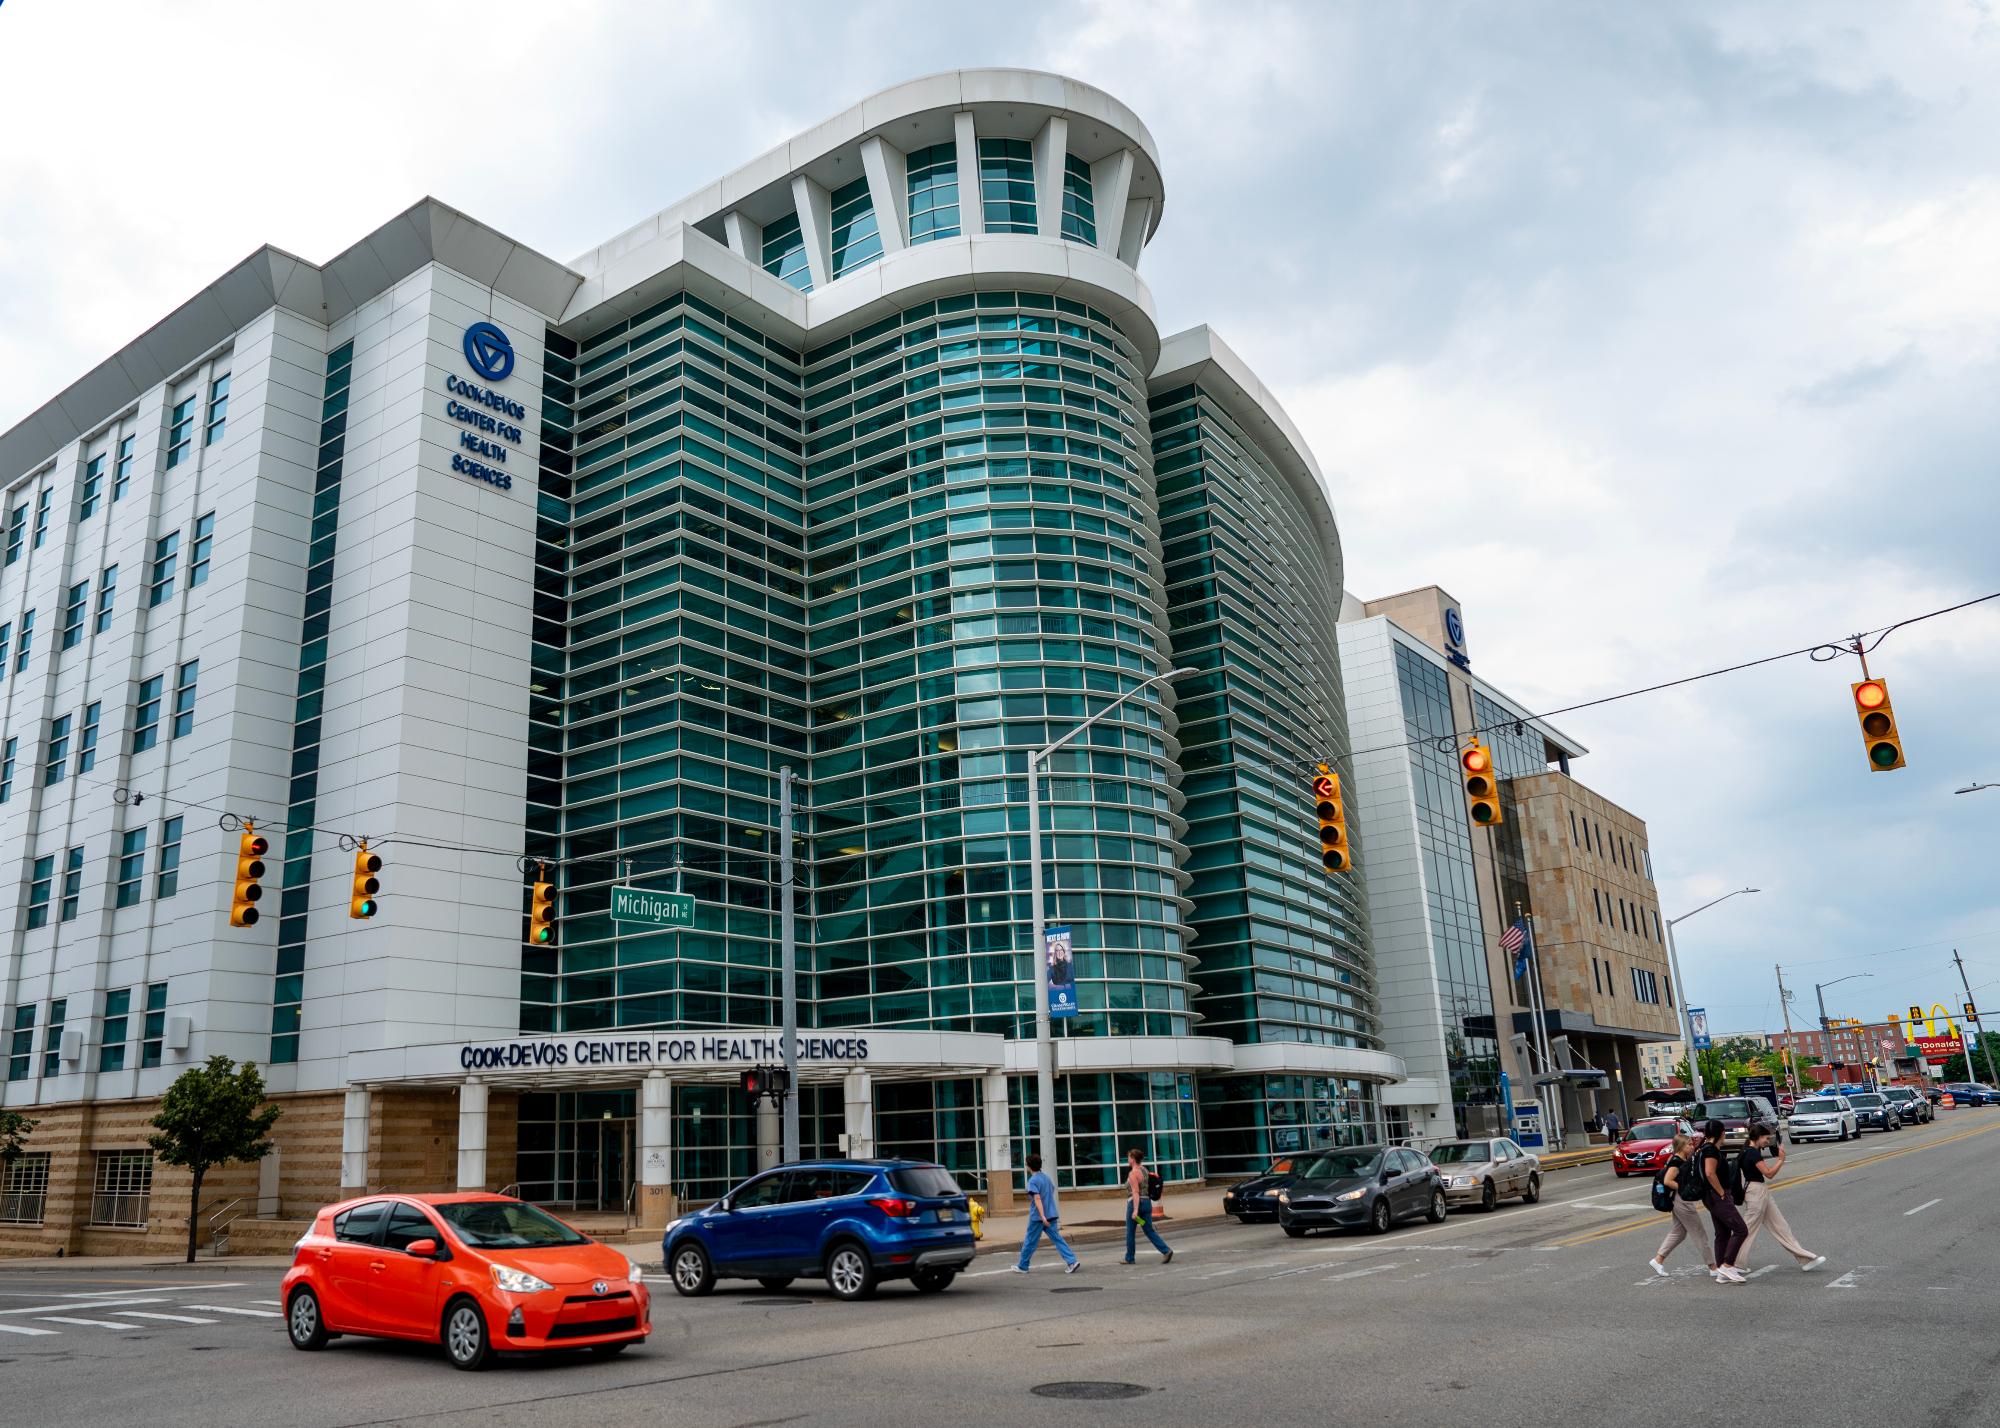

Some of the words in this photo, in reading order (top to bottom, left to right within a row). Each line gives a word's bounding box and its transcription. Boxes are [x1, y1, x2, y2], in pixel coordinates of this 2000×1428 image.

[447, 400, 496, 433] CENTER
[497, 422, 522, 444] FOR
[460, 431, 507, 463] HEALTH
[452, 453, 512, 490] SCIENCES
[617, 893, 679, 922] Michigan
[574, 1040, 652, 1064] CENTER
[657, 1039, 697, 1062] FOR
[702, 1036, 775, 1061] HEALTH
[649, 1187, 664, 1196] 301
